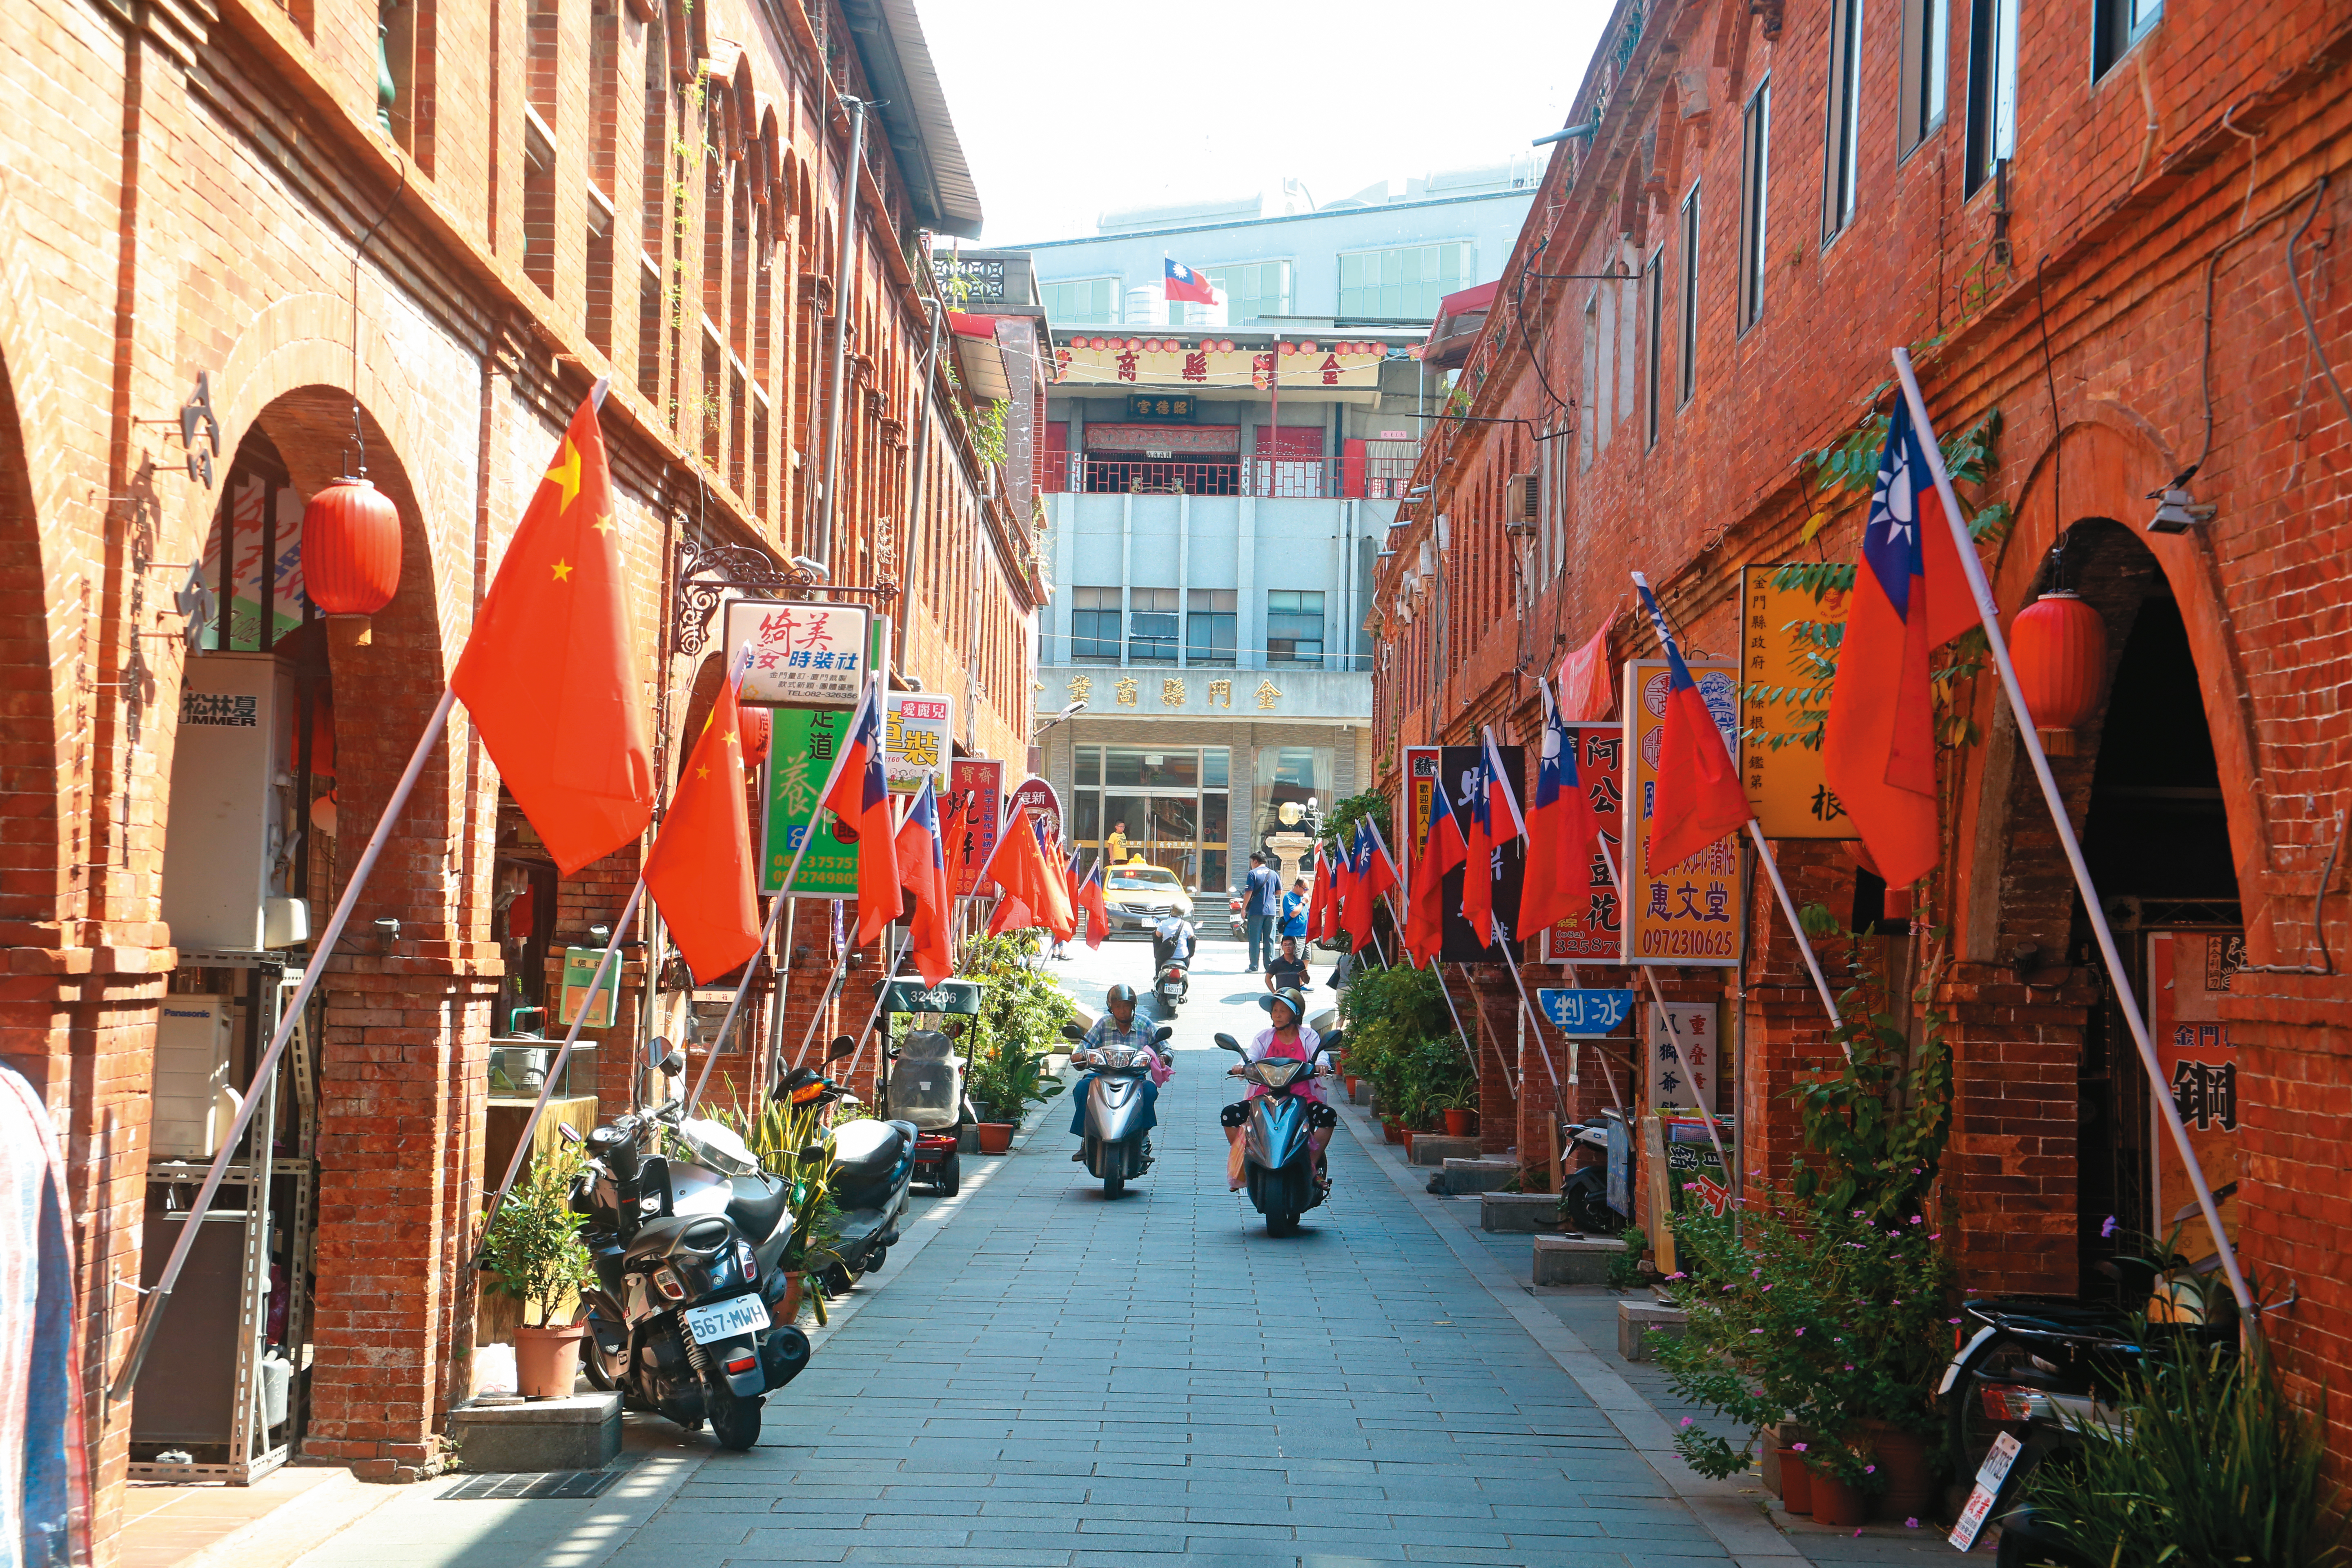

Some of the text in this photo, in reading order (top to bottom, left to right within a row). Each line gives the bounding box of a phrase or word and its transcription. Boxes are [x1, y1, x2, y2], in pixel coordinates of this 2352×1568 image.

[757, 608, 832, 656] 綺美
[788, 651, 858, 670] 時裝社
[788, 690, 858, 699] TEL:082-326356
[1035, 675, 1283, 709] 金門縣商業
[903, 703, 944, 718] 愛麗兒
[951, 766, 995, 785] 寶齋
[774, 855, 859, 869] 08-37575
[1646, 880, 1731, 923] 惠文堂
[1556, 930, 1585, 939] (082)
[1643, 929, 1733, 956] 0972310625
[911, 991, 956, 1004] 324206
[164, 1009, 210, 1018] Panasonic
[692, 1305, 765, 1338] 567-MWH
